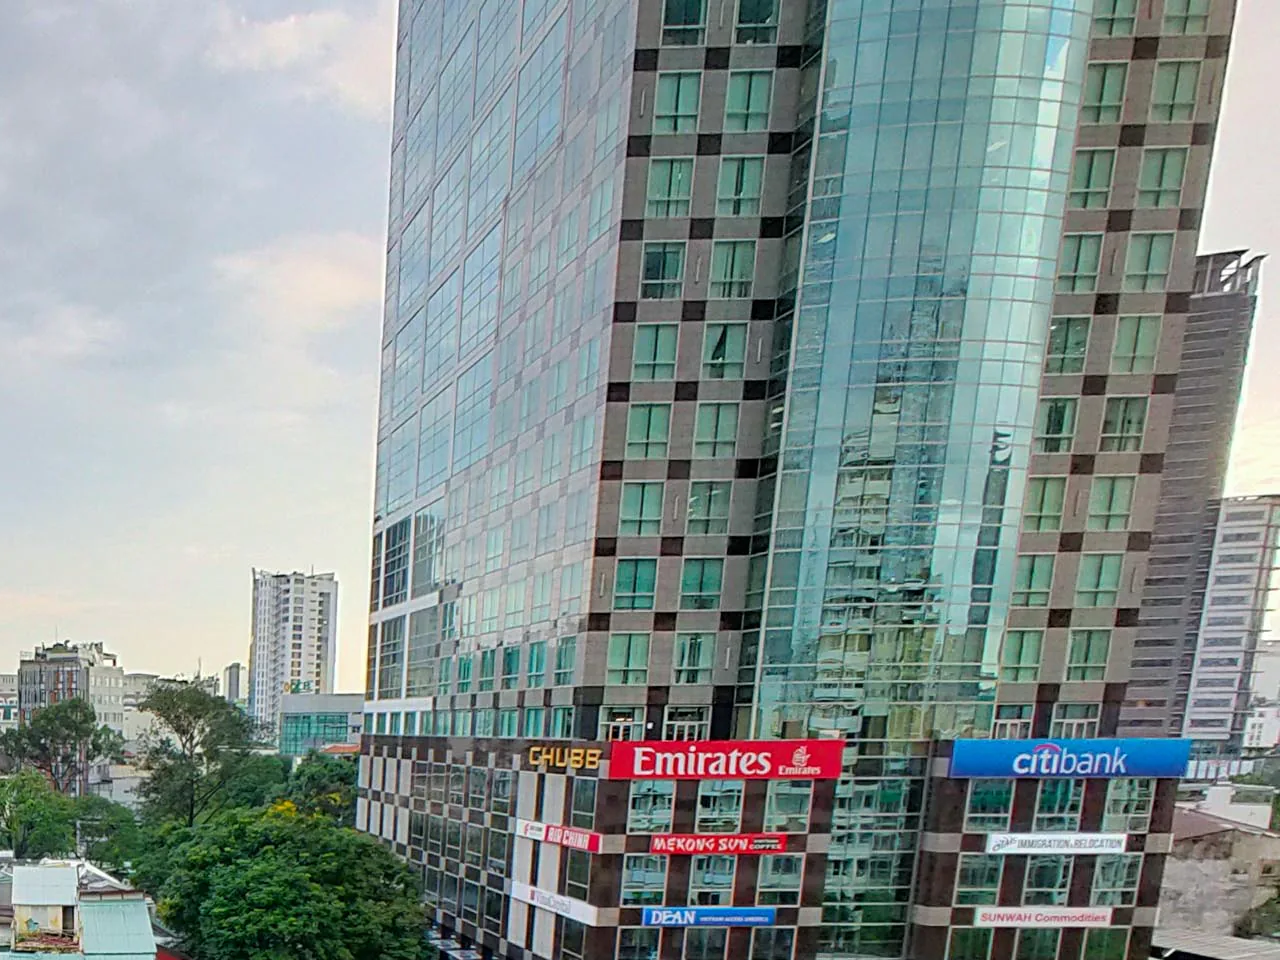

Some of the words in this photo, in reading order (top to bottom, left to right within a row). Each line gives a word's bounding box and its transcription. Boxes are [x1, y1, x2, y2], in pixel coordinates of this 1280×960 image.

[529, 746, 602, 769] CHUBB
[634, 745, 771, 776] Emirates
[1013, 745, 1128, 774] citibank
[778, 764, 821, 775] Emirates
[562, 829, 589, 850] CHINA
[654, 838, 715, 851] MEKONG
[718, 838, 749, 851] SUN
[1017, 839, 1070, 849] IMMIGRATION
[1074, 839, 1122, 849] RELOCATION
[650, 911, 696, 925] DEAN
[981, 912, 1032, 922] SUNWAH
[1035, 912, 1107, 922] Commodities
